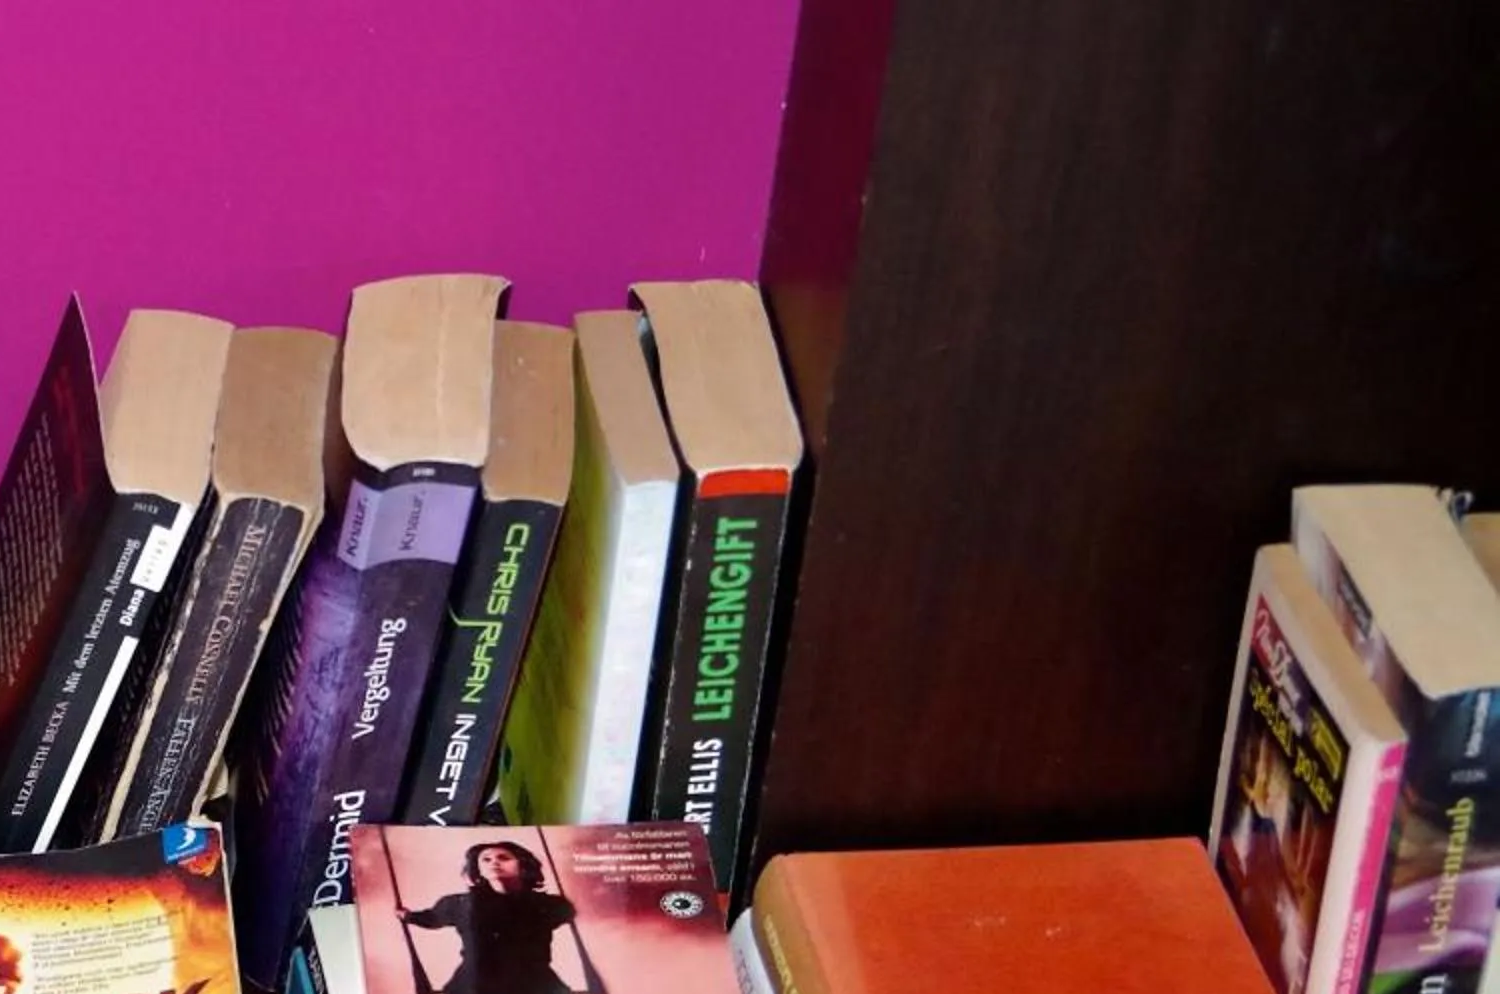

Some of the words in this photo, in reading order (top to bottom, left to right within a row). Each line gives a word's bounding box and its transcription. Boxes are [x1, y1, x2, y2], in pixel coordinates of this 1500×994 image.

[119, 588, 145, 627] Diana
[218, 524, 267, 613] MICHAEL
[486, 523, 530, 615] CHRIS
[450, 607, 502, 703] RYAN
[692, 517, 758, 721] LEICHENGIFT
[11, 744, 50, 817] ELIZABETH
[41, 700, 70, 744] BECKA
[62, 671, 82, 693] Mit
[73, 640, 94, 669] dem
[104, 538, 141, 595] Atemzug
[352, 617, 408, 739] Vergeltung
[436, 713, 477, 800] INGET
[687, 738, 723, 795] ELLIS
[1419, 797, 1475, 953] Leichenraub
